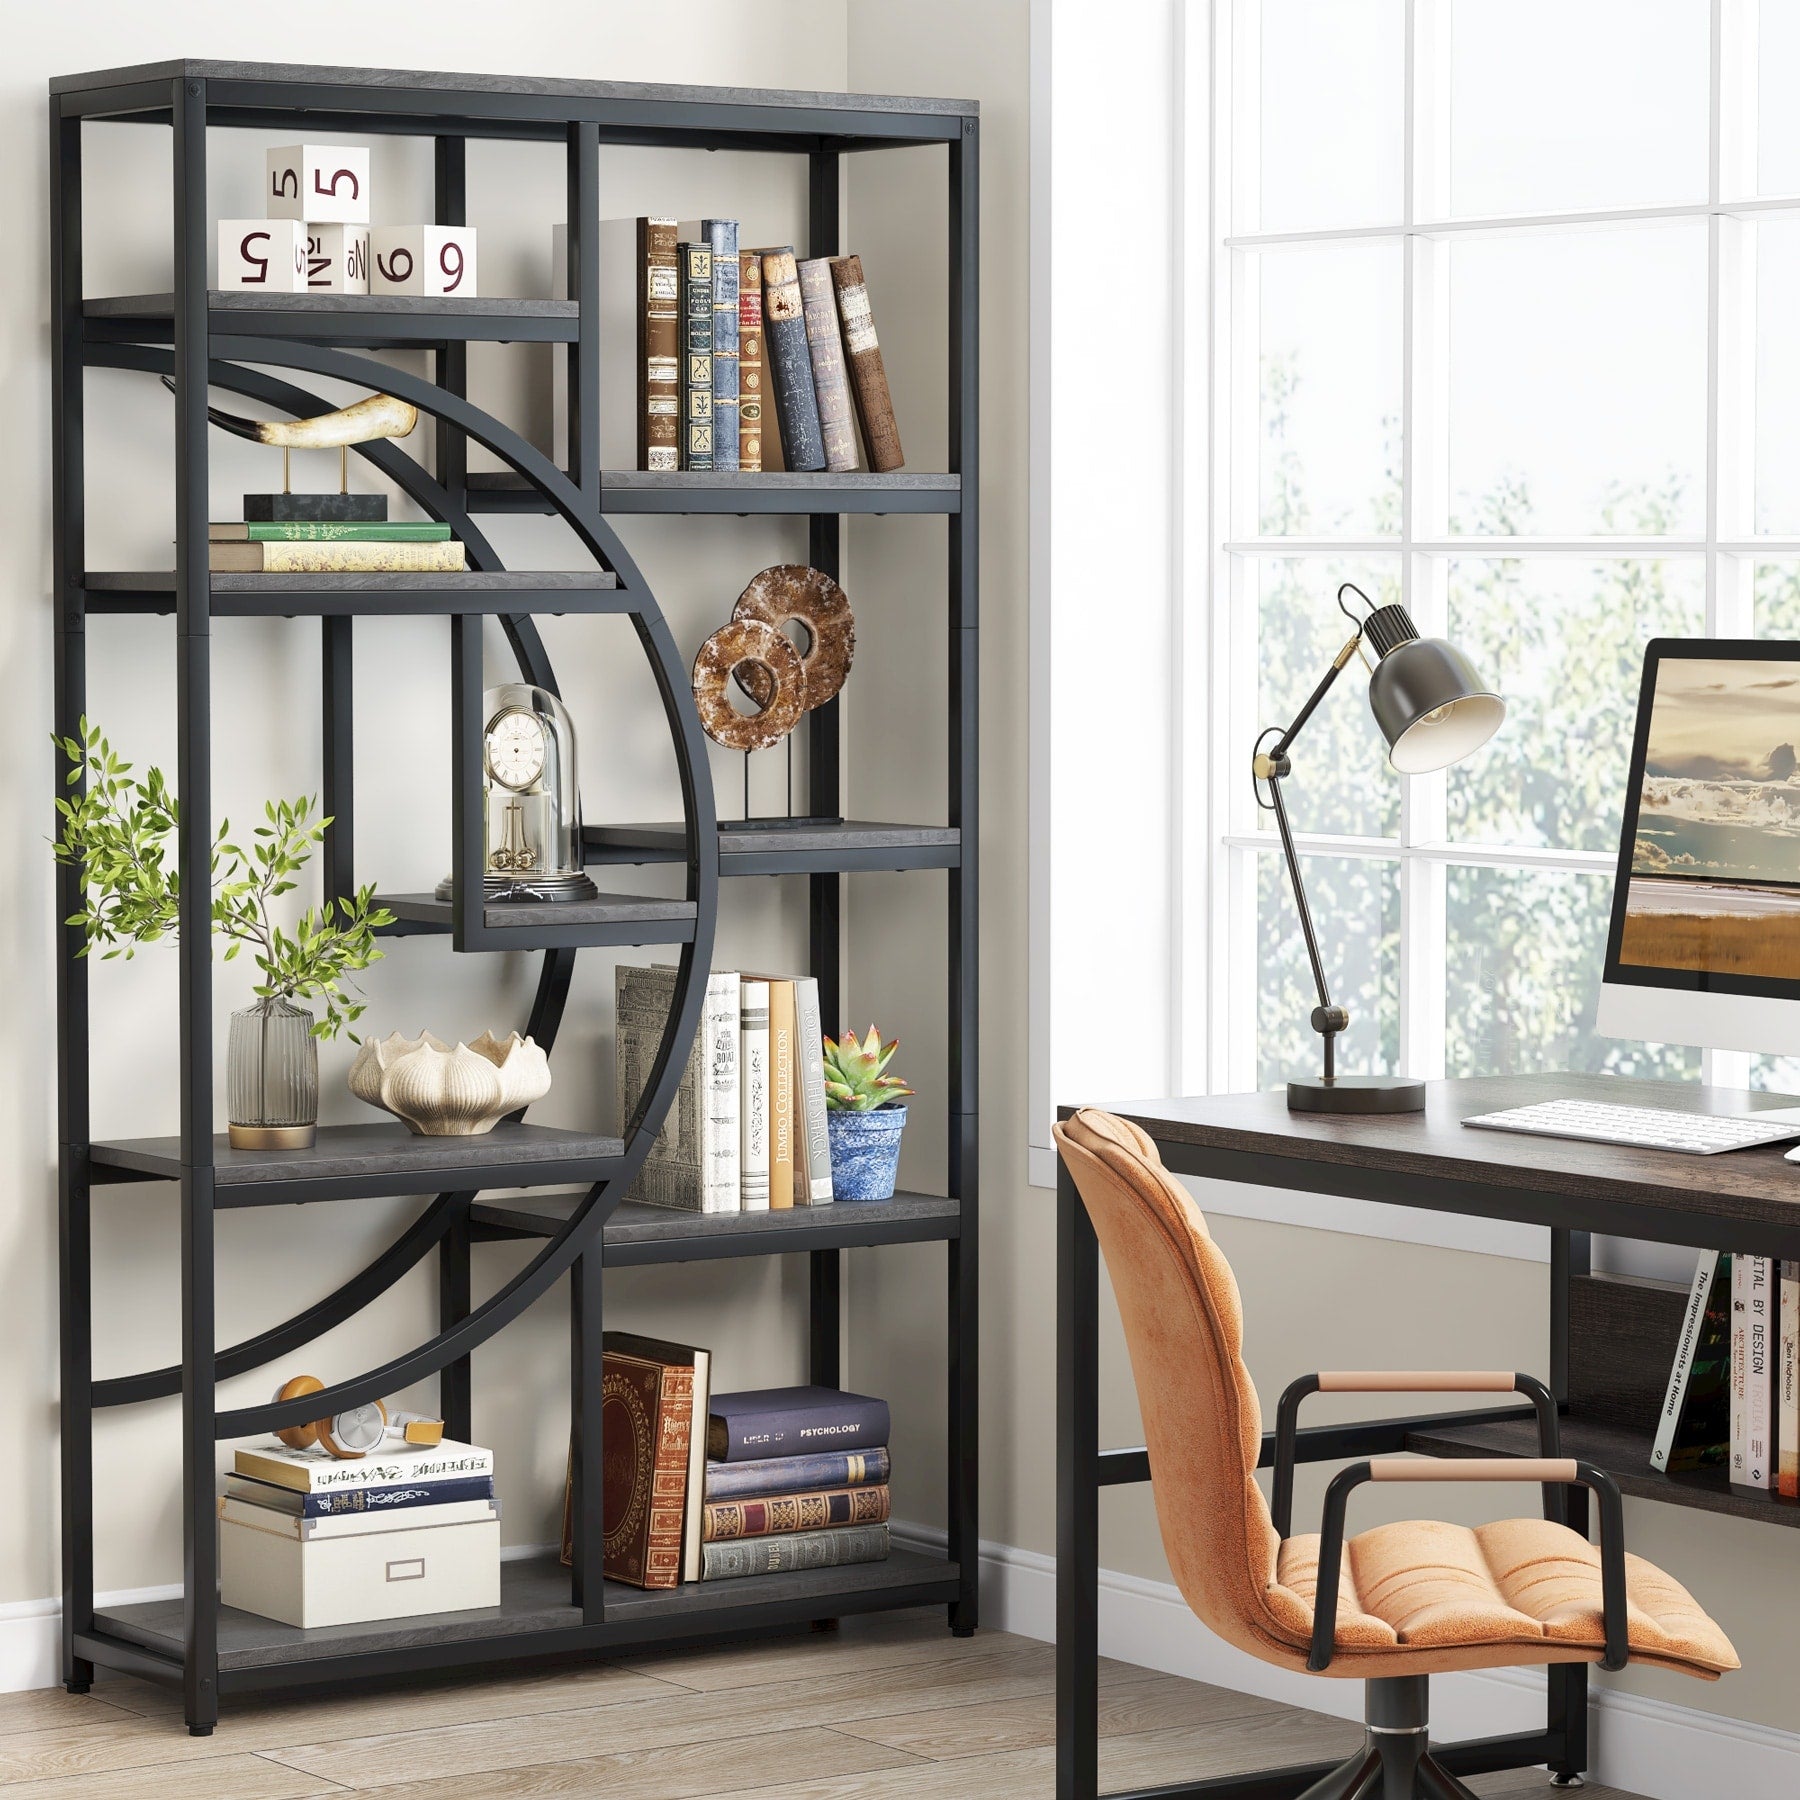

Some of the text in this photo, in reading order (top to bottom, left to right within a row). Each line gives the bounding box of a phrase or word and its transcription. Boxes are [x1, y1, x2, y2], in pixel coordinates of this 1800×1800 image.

[273, 168, 298, 199] 5
[315, 168, 359, 201] 5
[240, 232, 271, 283] 5
[439, 241, 464, 293] 9
[803, 1005, 818, 1061] YOUNG
[775, 1028, 791, 1164] JUMBO COLLECTION
[807, 1074, 827, 1162] THE SHACK
[1753, 1299, 1765, 1316] BY
[1666, 1270, 1709, 1417] The Impressionists at Home
[1737, 1327, 1745, 1400] ARCHITECTURE
[1752, 1324, 1764, 1375] DESIGN
[1785, 1360, 1793, 1401] Nicholson
[799, 1423, 862, 1438] PSYCHOLOGY
